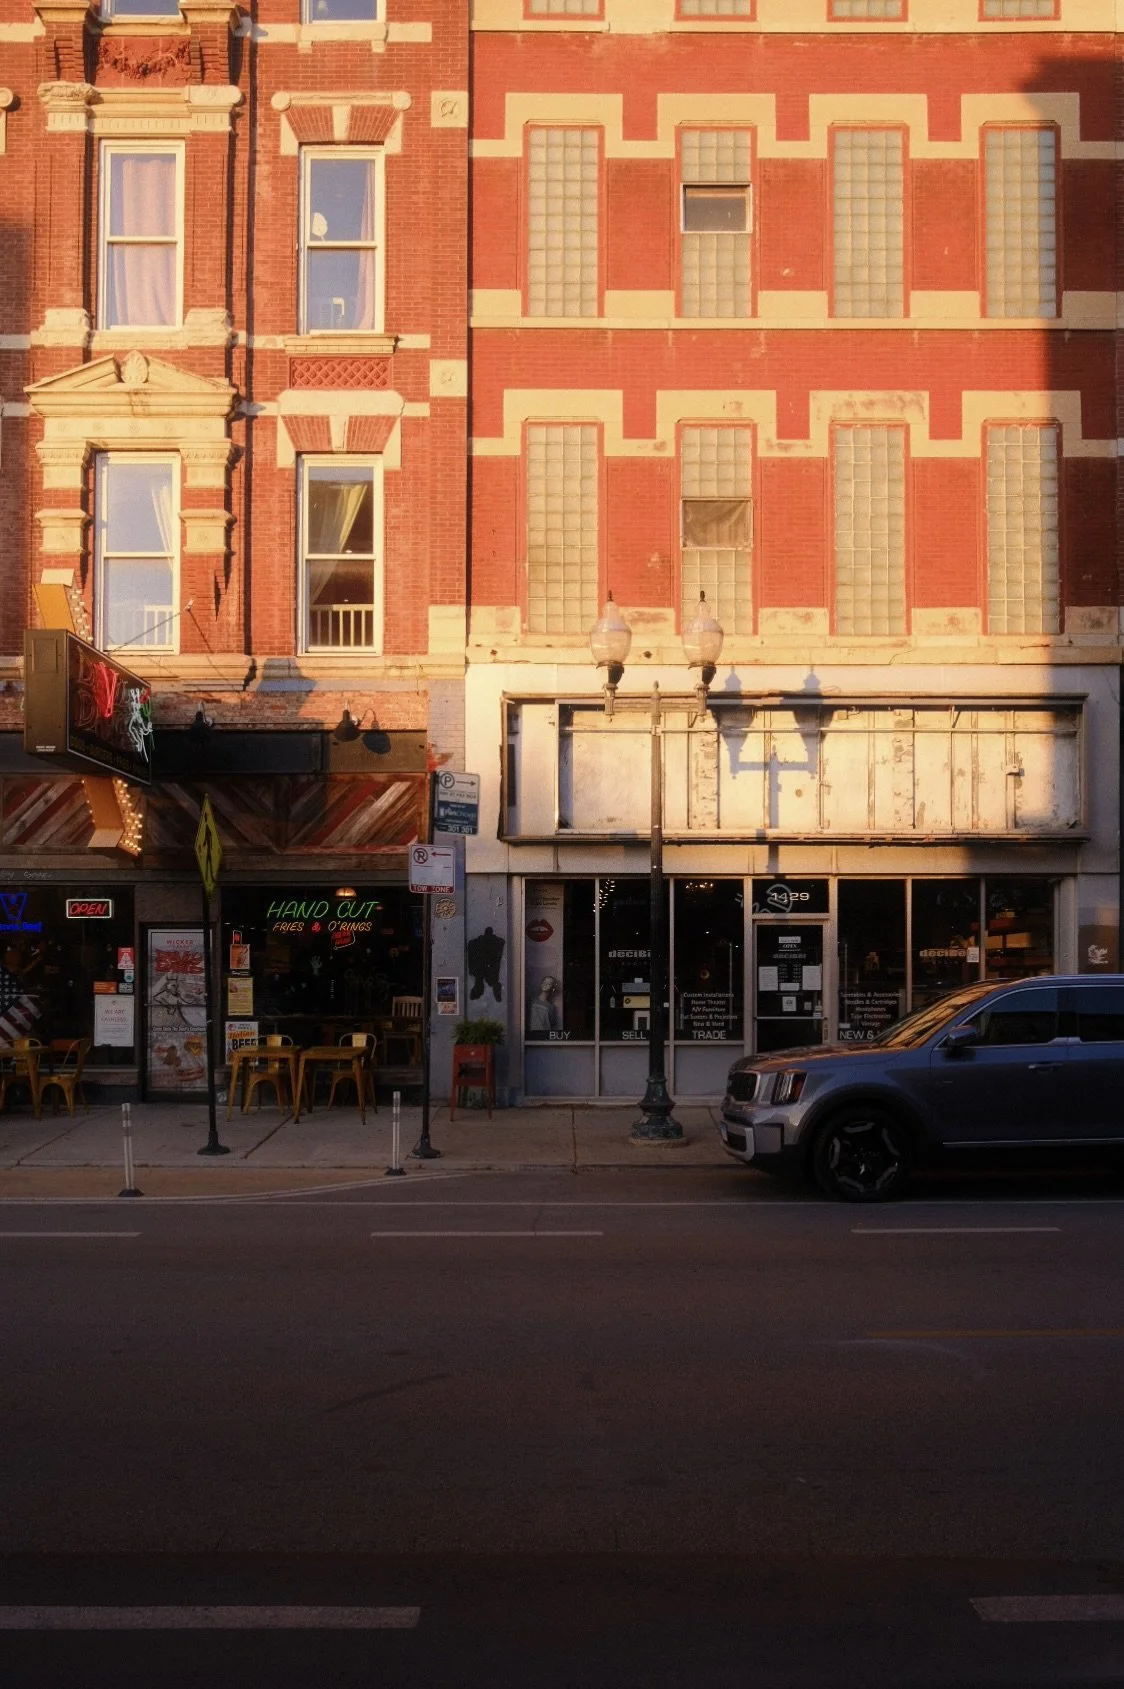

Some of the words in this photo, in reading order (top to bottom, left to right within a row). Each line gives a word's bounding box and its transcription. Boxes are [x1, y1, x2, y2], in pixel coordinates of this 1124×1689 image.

[771, 892, 809, 902] 1429
[70, 902, 107, 915] OPEN
[267, 900, 329, 919] HAND
[337, 900, 380, 919] CUT
[273, 921, 305, 932] FRIES
[311, 921, 321, 933] &
[328, 920, 373, 932] O'RINGS
[549, 1031, 571, 1040] BUY
[622, 1031, 647, 1040] SELL
[692, 1031, 727, 1040] TRADE
[840, 1031, 864, 1040] NEW
[866, 1031, 874, 1040] &
